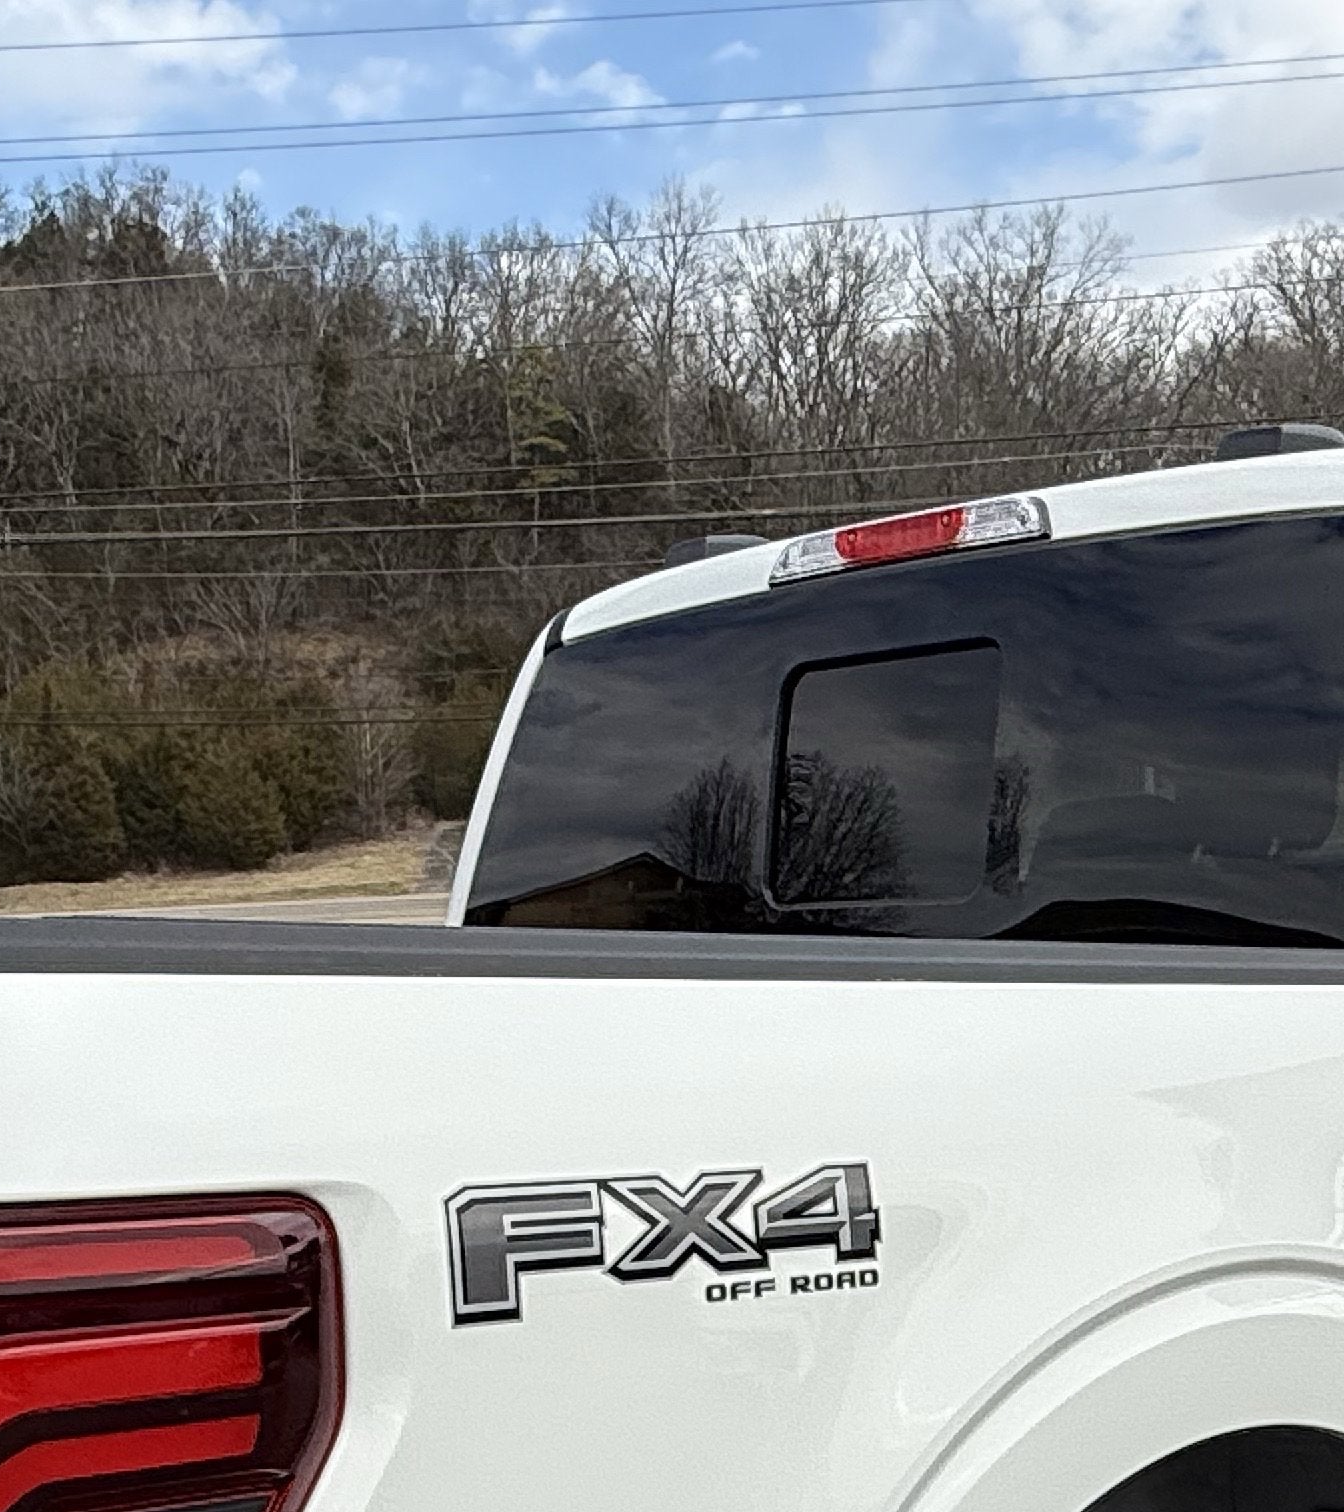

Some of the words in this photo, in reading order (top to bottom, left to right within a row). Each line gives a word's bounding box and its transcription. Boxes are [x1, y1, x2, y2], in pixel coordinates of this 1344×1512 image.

[444, 1162, 882, 1329] FX4
[706, 1278, 776, 1303] OFF
[790, 1268, 879, 1295] ROAD
